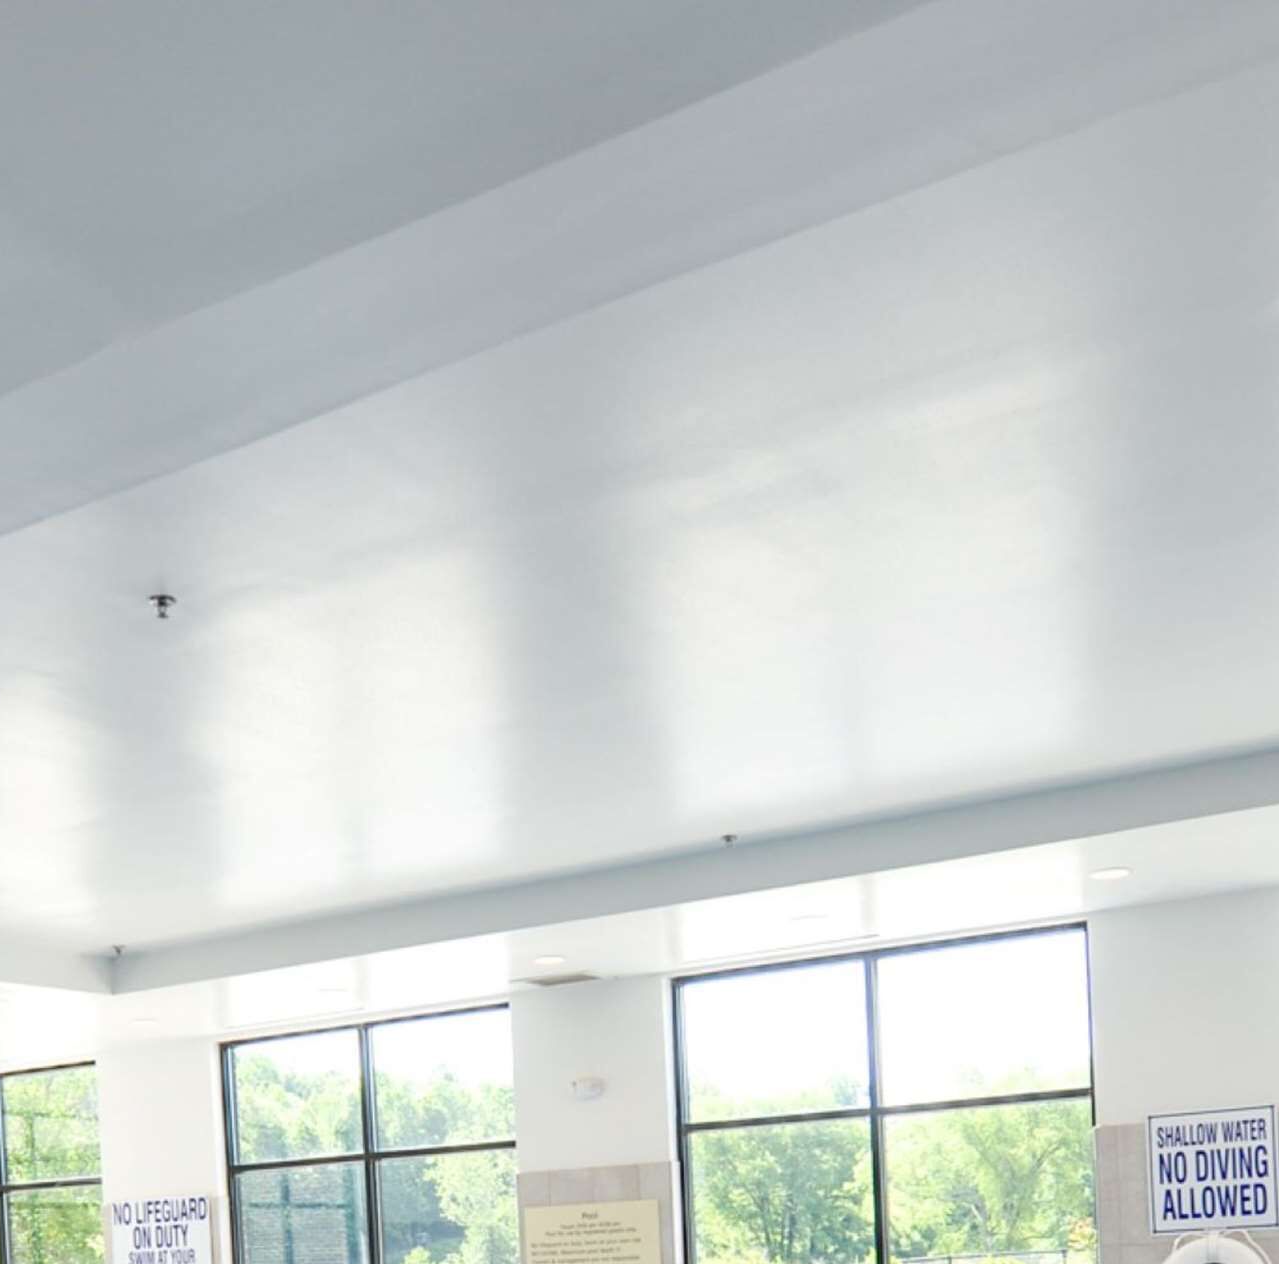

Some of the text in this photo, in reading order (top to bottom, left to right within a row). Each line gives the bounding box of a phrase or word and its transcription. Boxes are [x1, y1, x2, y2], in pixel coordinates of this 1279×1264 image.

[1157, 1118, 1267, 1149] SHALLOW WATER
[1159, 1145, 1269, 1185] NO DIVING
[113, 1197, 207, 1225] NO LIFEGUARD
[1163, 1183, 1268, 1220] ALLOWED
[133, 1224, 188, 1250] ON DUTY
[158, 1249, 168, 1264] AT
[170, 1247, 196, 1264] YOUR
